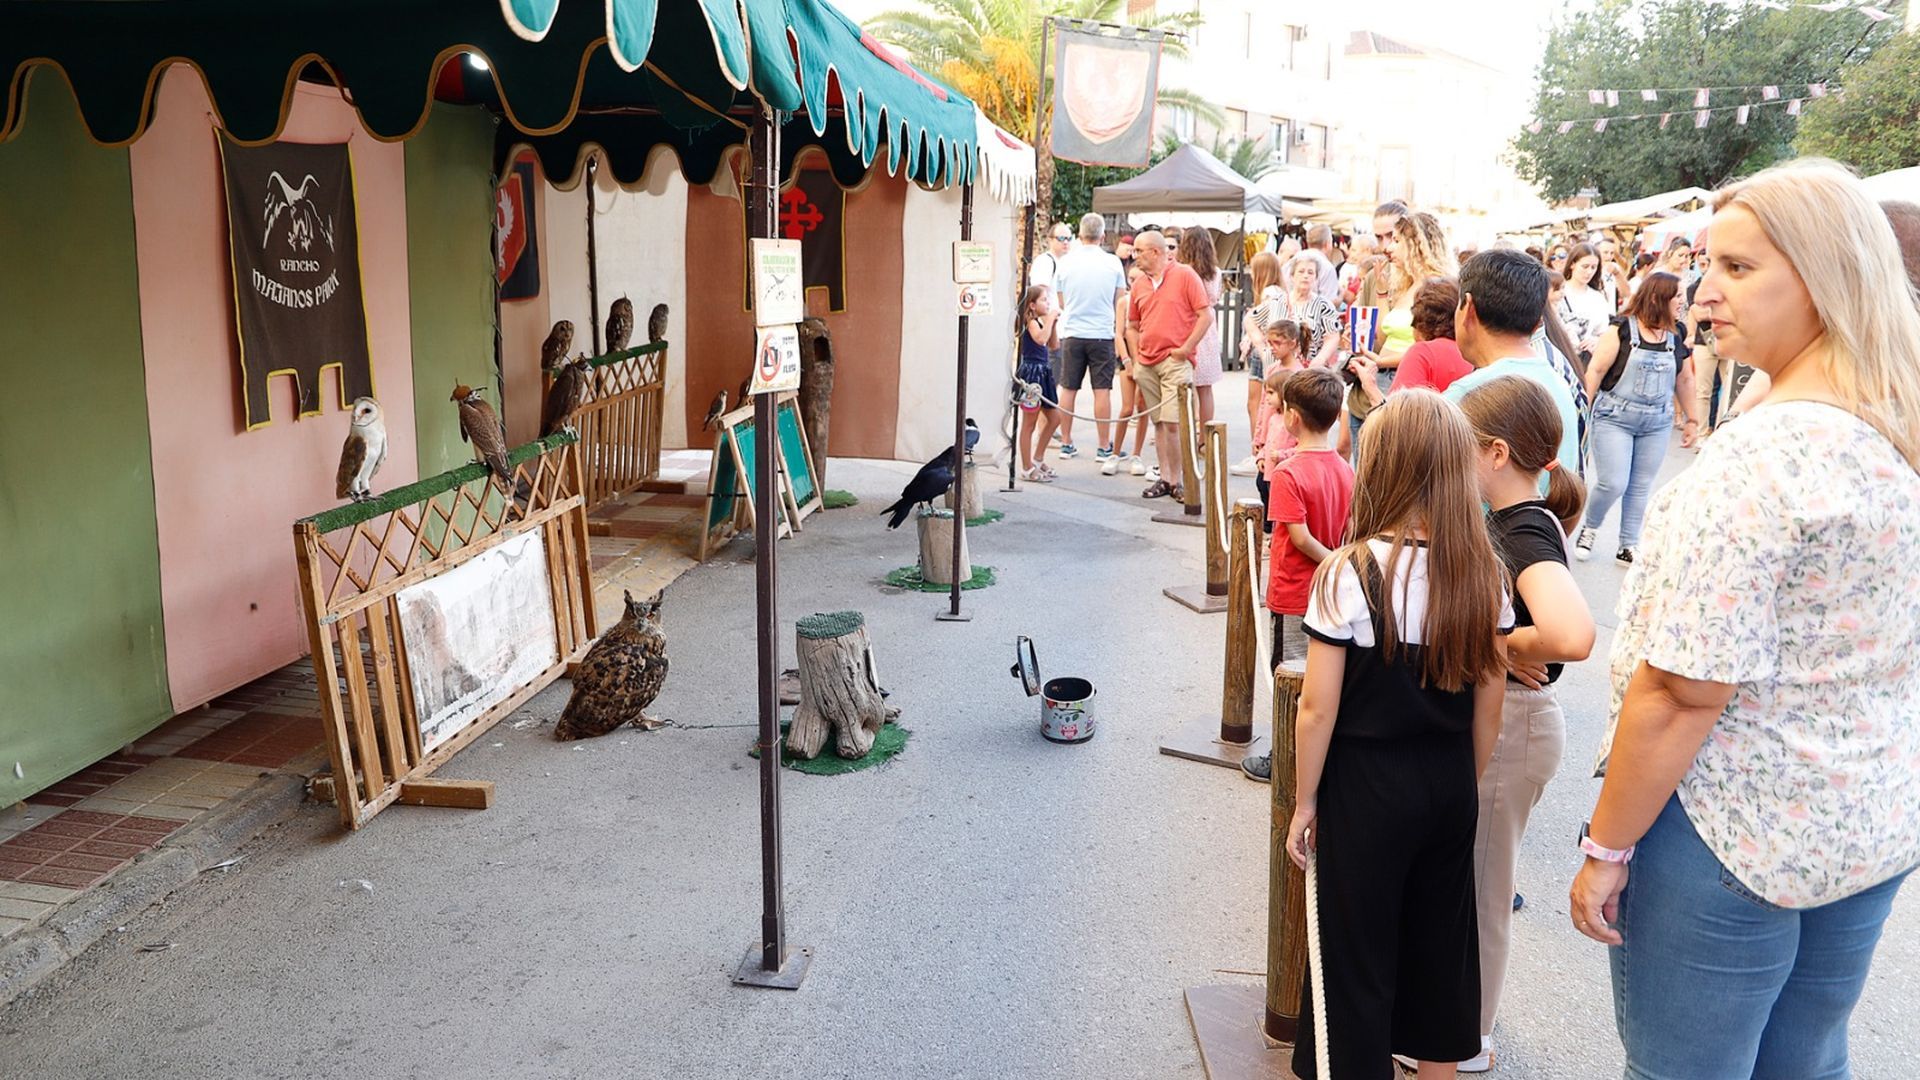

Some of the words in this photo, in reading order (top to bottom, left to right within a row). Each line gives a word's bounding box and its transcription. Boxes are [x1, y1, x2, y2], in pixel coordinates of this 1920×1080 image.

[280, 259, 320, 272] RANCHO
[252, 268, 314, 309] MAJANOS
[315, 268, 340, 305] PARK
